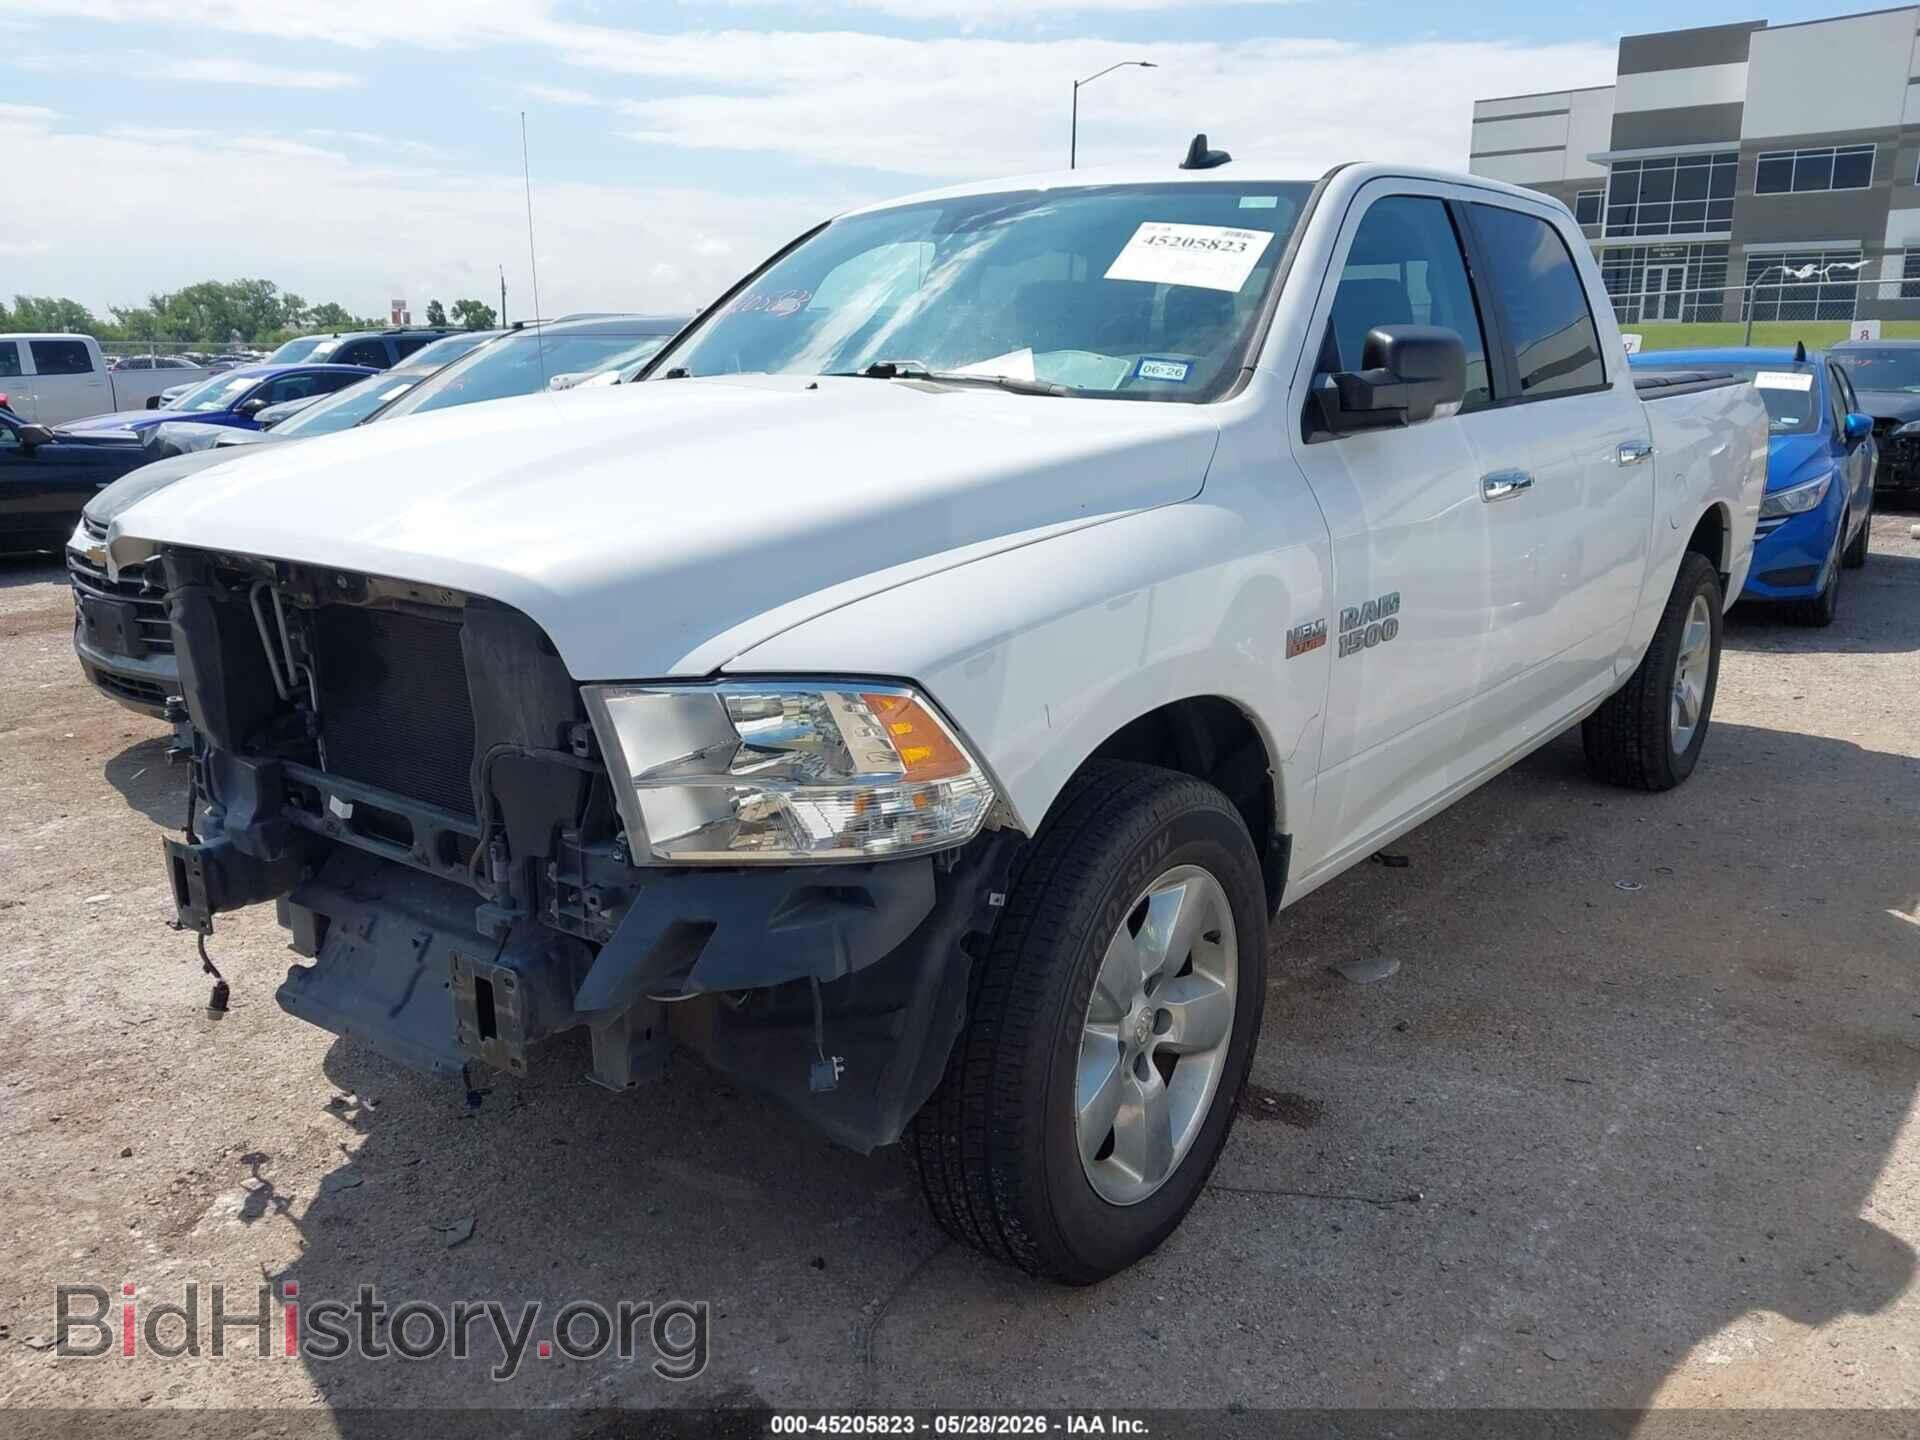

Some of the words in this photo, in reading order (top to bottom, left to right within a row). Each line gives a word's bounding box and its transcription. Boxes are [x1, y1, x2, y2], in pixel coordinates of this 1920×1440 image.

[1143, 235, 1248, 253] 45205823
[1339, 591, 1400, 633] RAM
[1338, 617, 1399, 658] 1500
